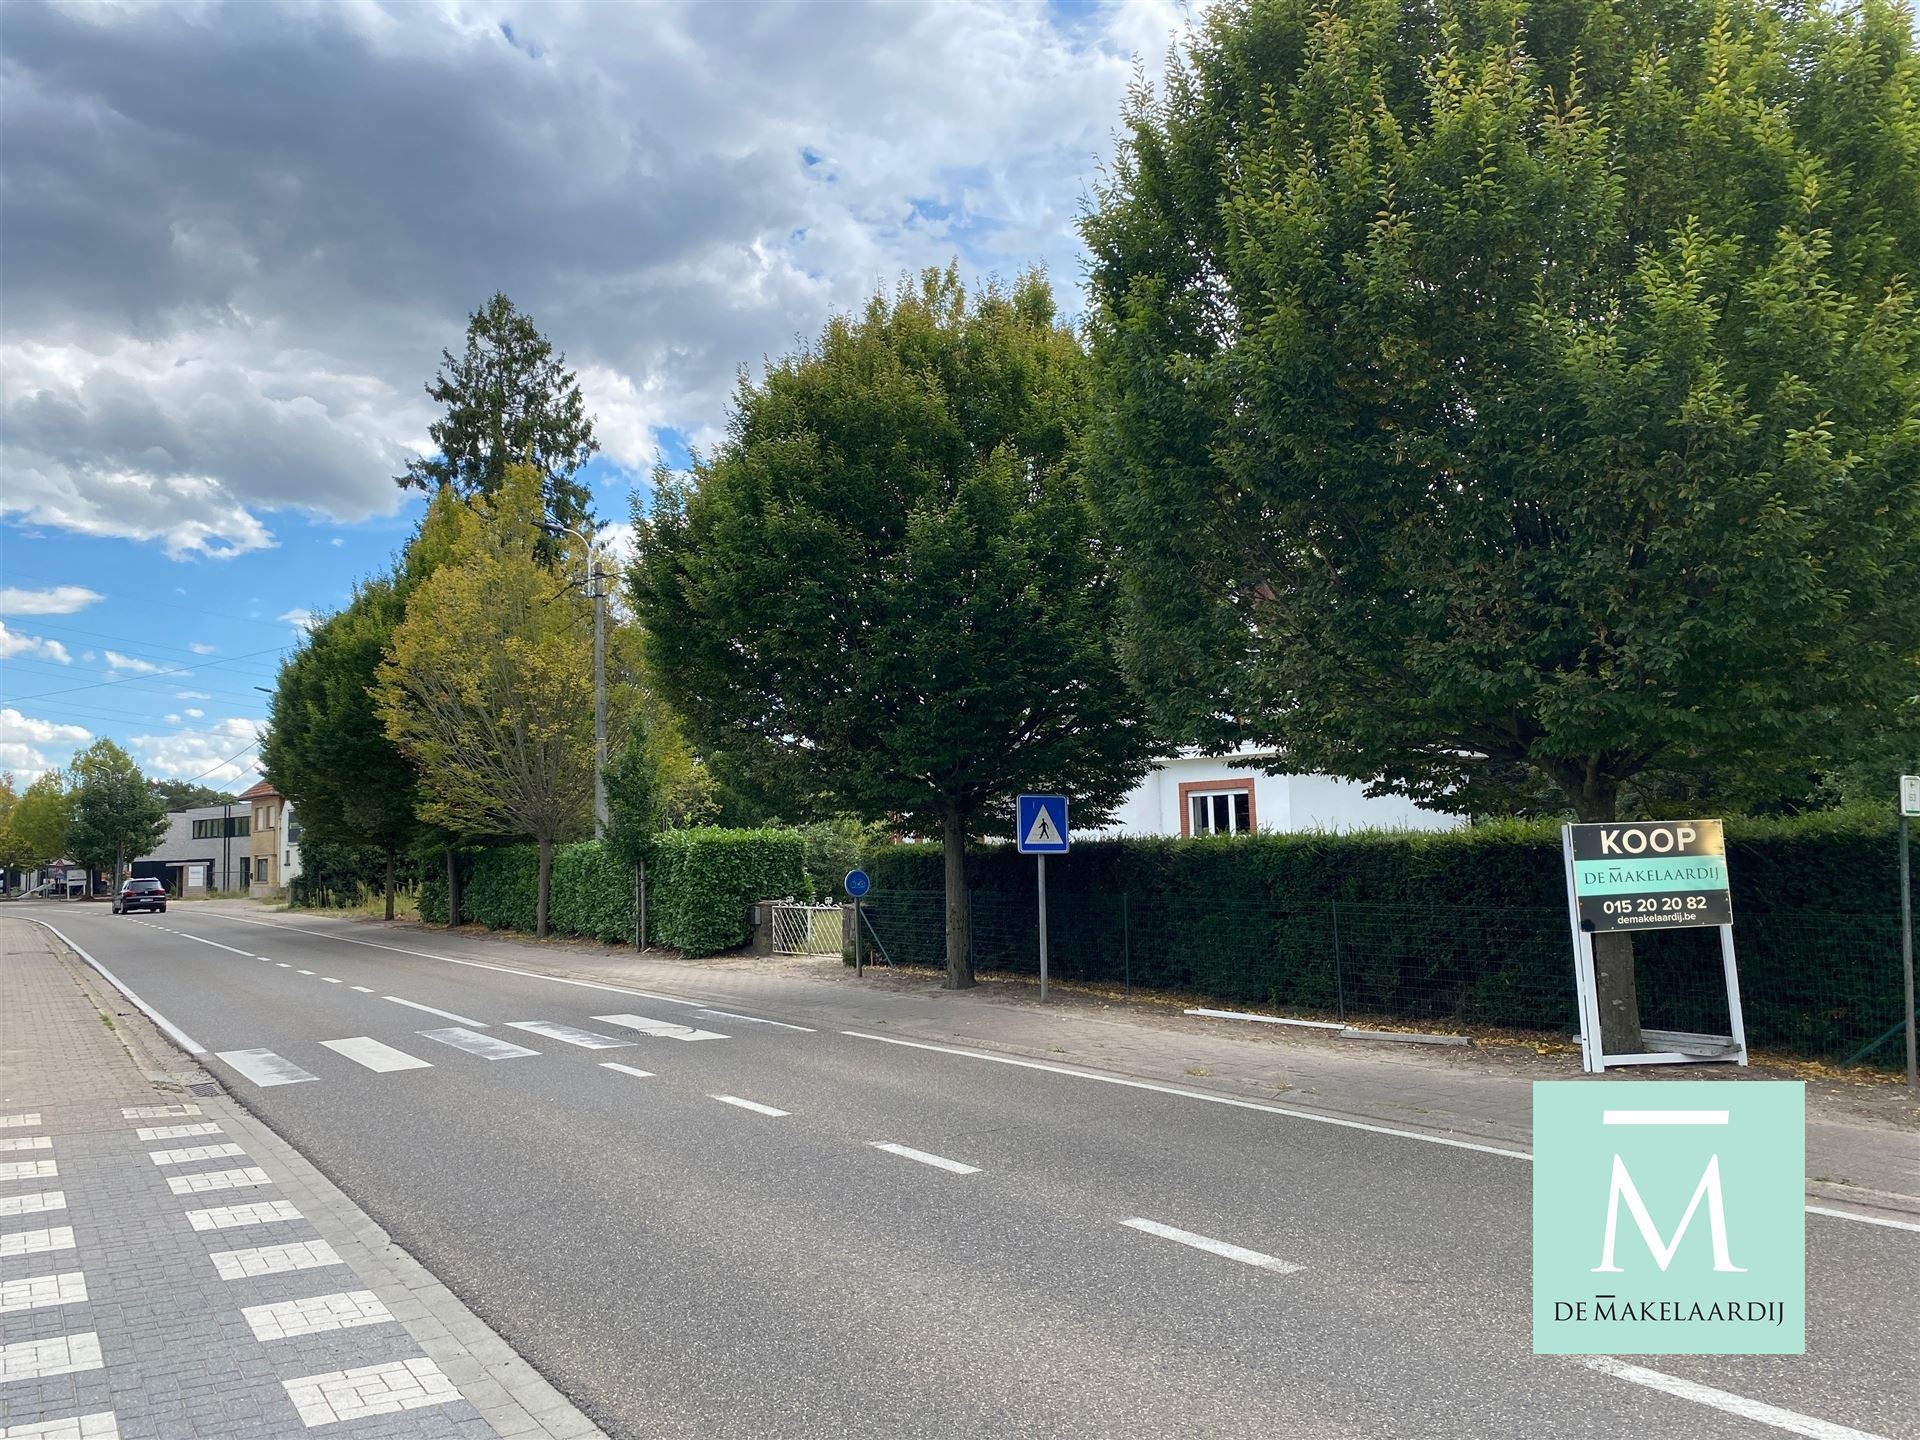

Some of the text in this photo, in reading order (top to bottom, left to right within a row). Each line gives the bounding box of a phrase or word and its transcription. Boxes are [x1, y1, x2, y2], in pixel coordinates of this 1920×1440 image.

[1600, 828, 1697, 855] KOOP
[1584, 867, 1719, 885] DE MAKELAARDIJ
[1603, 896, 1707, 914] 015 20 20 82
[1617, 912, 1697, 925] demakelaardij.be
